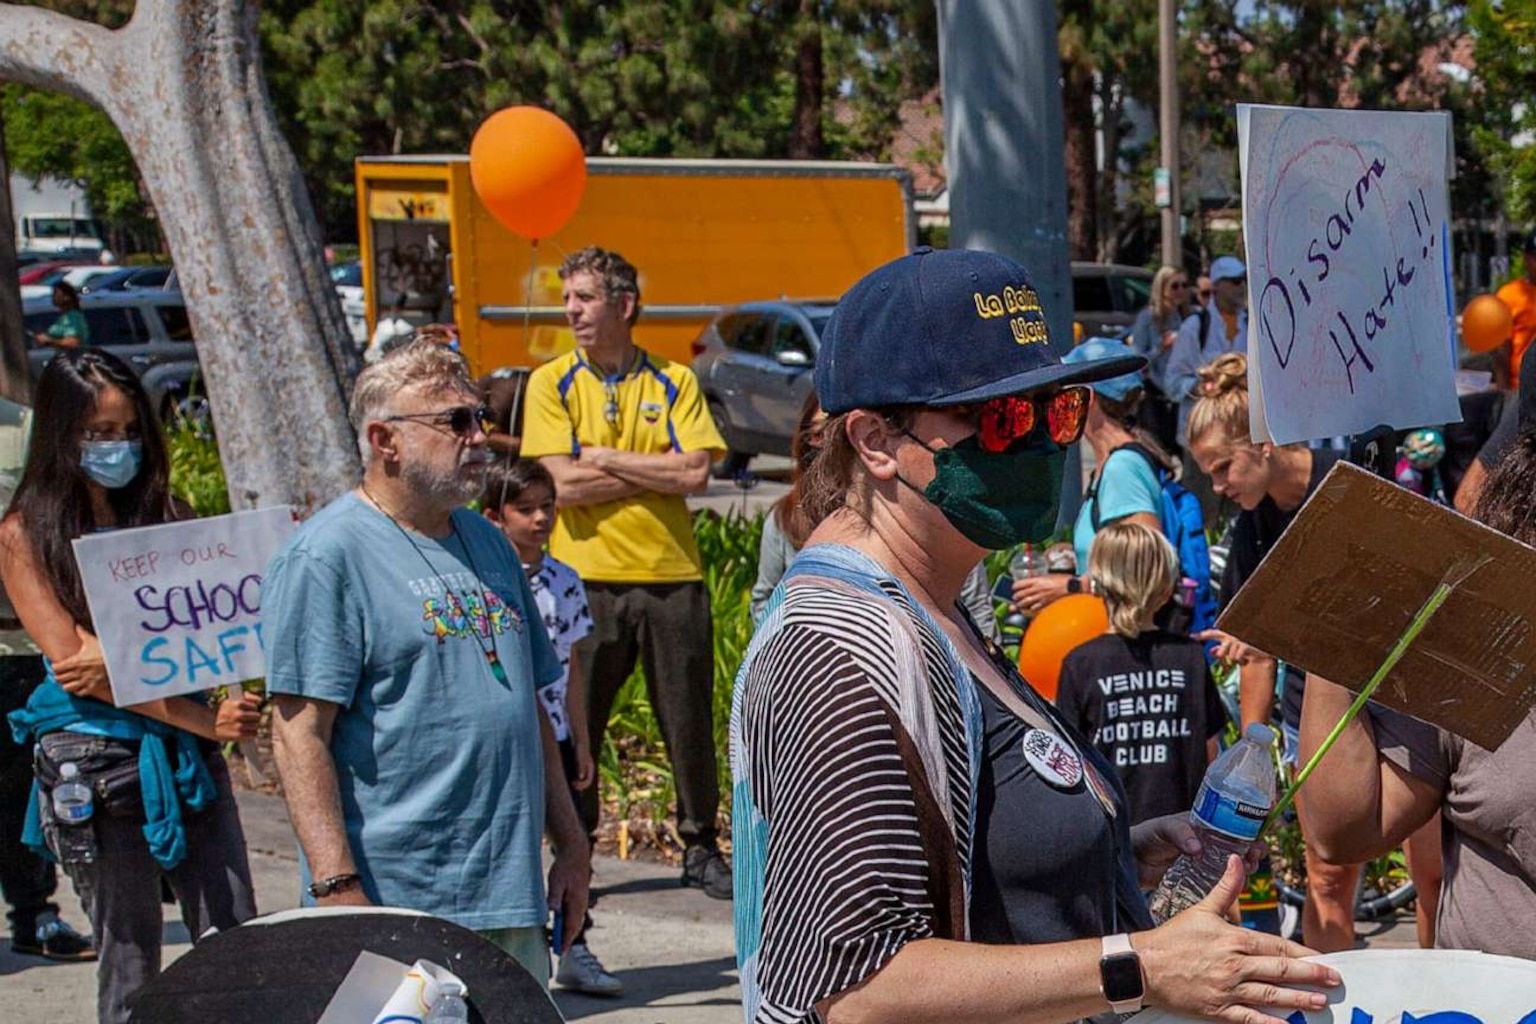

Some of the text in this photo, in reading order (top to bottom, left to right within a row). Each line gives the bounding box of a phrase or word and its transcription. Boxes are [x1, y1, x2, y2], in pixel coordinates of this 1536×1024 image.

[1260, 158, 1386, 369] Disarm
[974, 292, 1005, 319] La
[108, 542, 238, 582] KEEP OUR
[133, 574, 263, 633] SCHOO
[1097, 669, 1186, 696] VENICE
[1106, 694, 1178, 719] BEACH
[1115, 744, 1168, 767] CLUB
